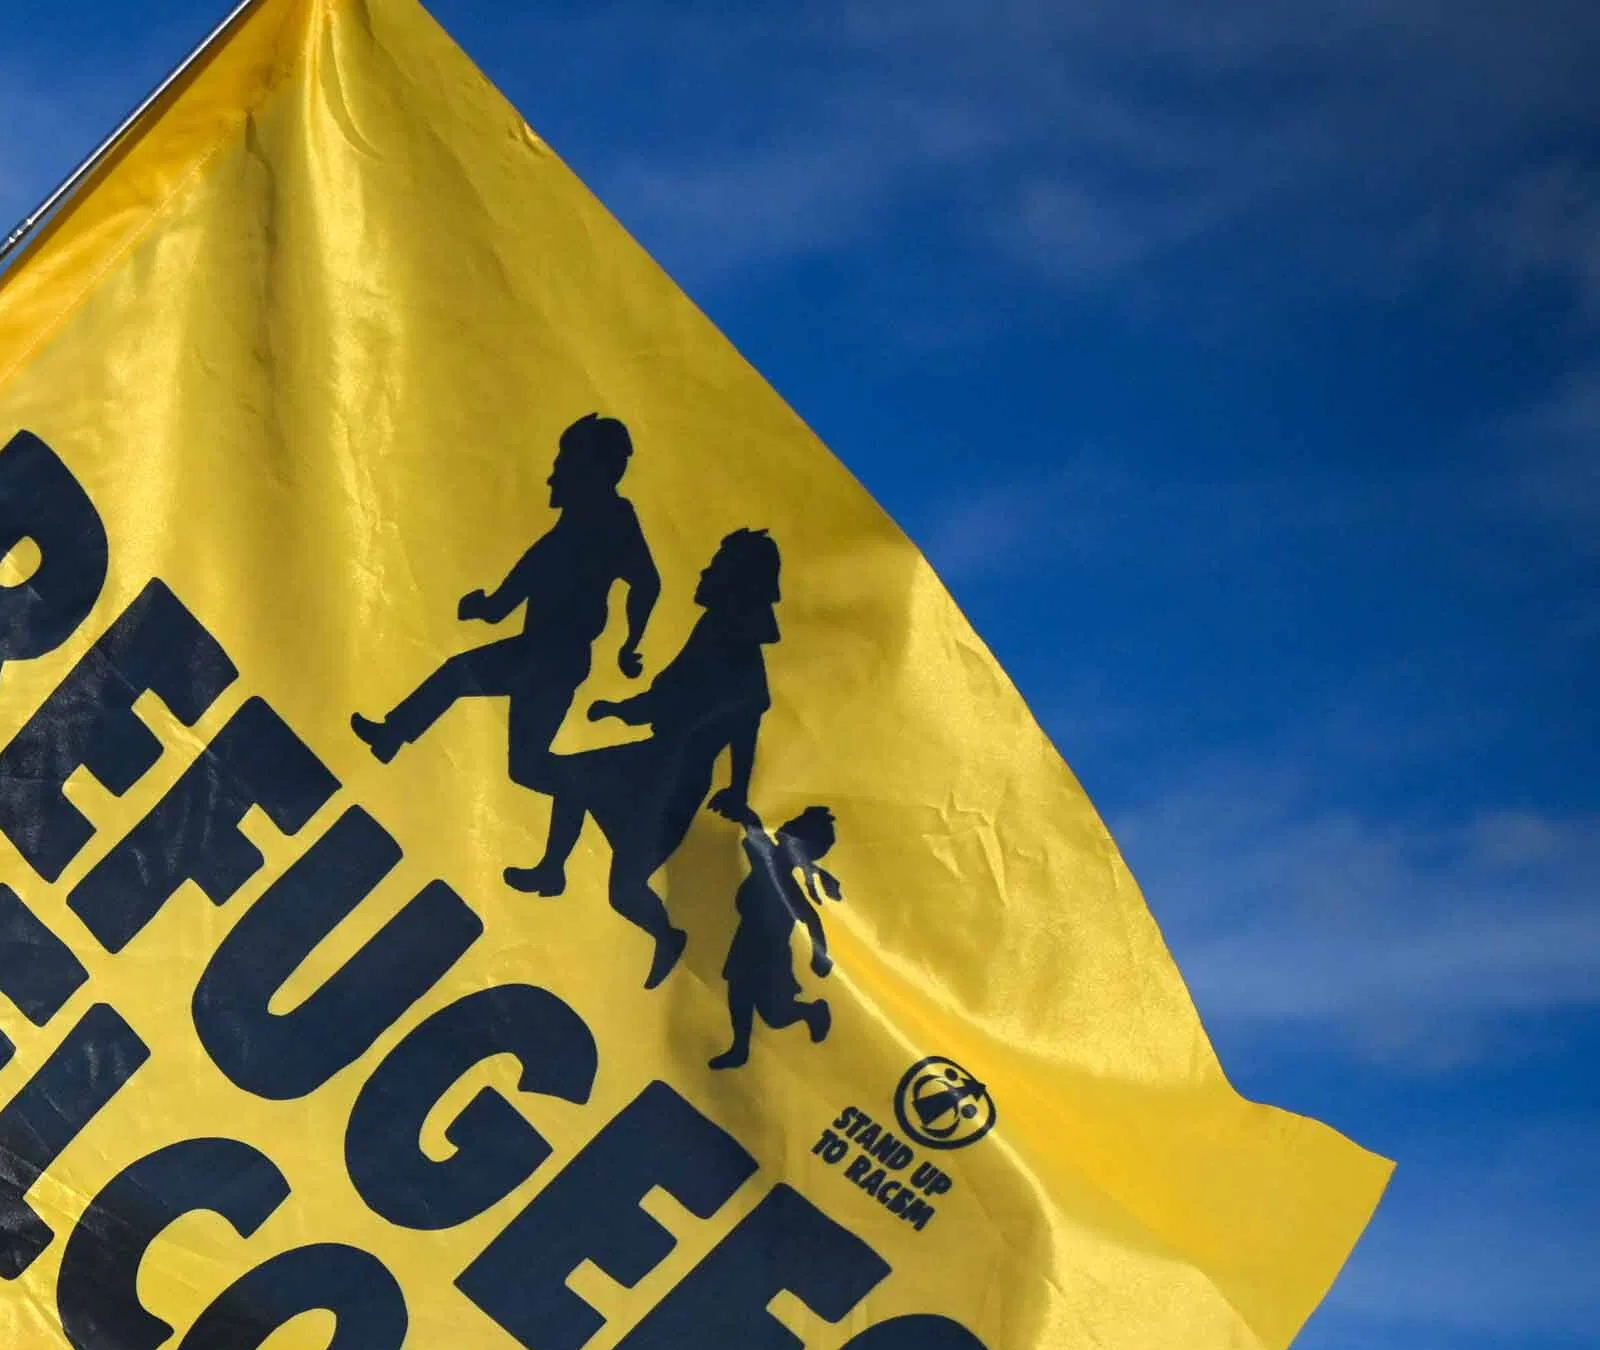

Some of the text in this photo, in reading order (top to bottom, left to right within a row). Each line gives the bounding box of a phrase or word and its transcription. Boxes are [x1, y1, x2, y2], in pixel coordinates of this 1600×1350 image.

[811, 1129, 849, 1164] TO
[833, 1106, 952, 1196] STAND UP
